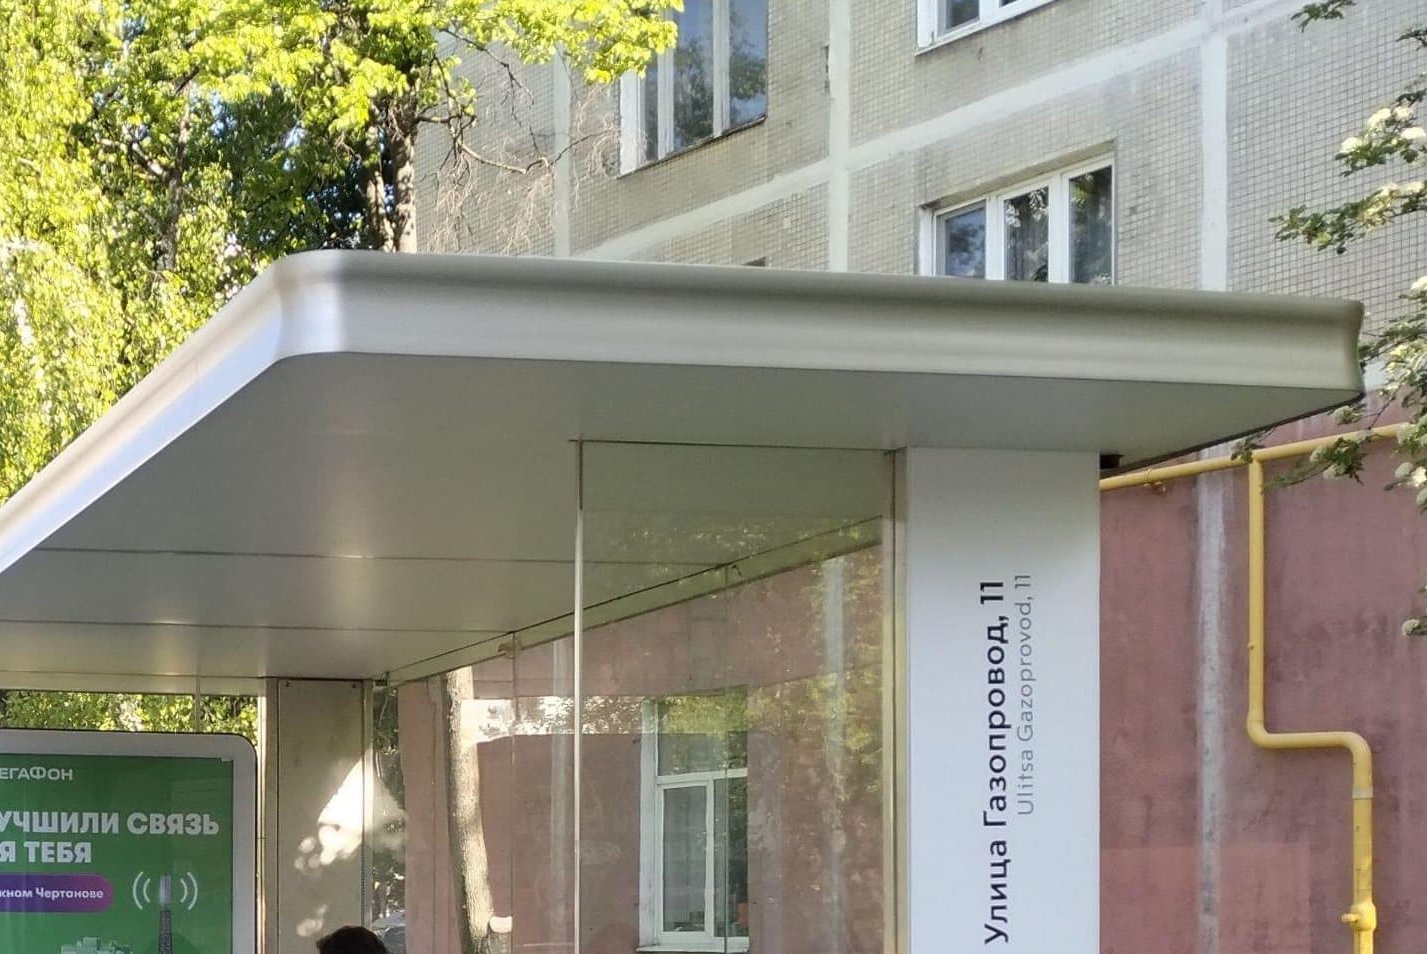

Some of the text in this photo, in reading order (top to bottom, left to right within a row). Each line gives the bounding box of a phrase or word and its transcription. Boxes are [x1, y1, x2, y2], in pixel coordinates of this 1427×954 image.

[1015, 575, 1037, 815] Ulitsa Gazoprovod, 11
[980, 582, 1012, 944] Улица Газопровод, 11
[127, 812, 220, 835] СВЯЗЬ
[24, 841, 92, 864] ТЕБЯ
[35, 887, 105, 901] Чертанове
